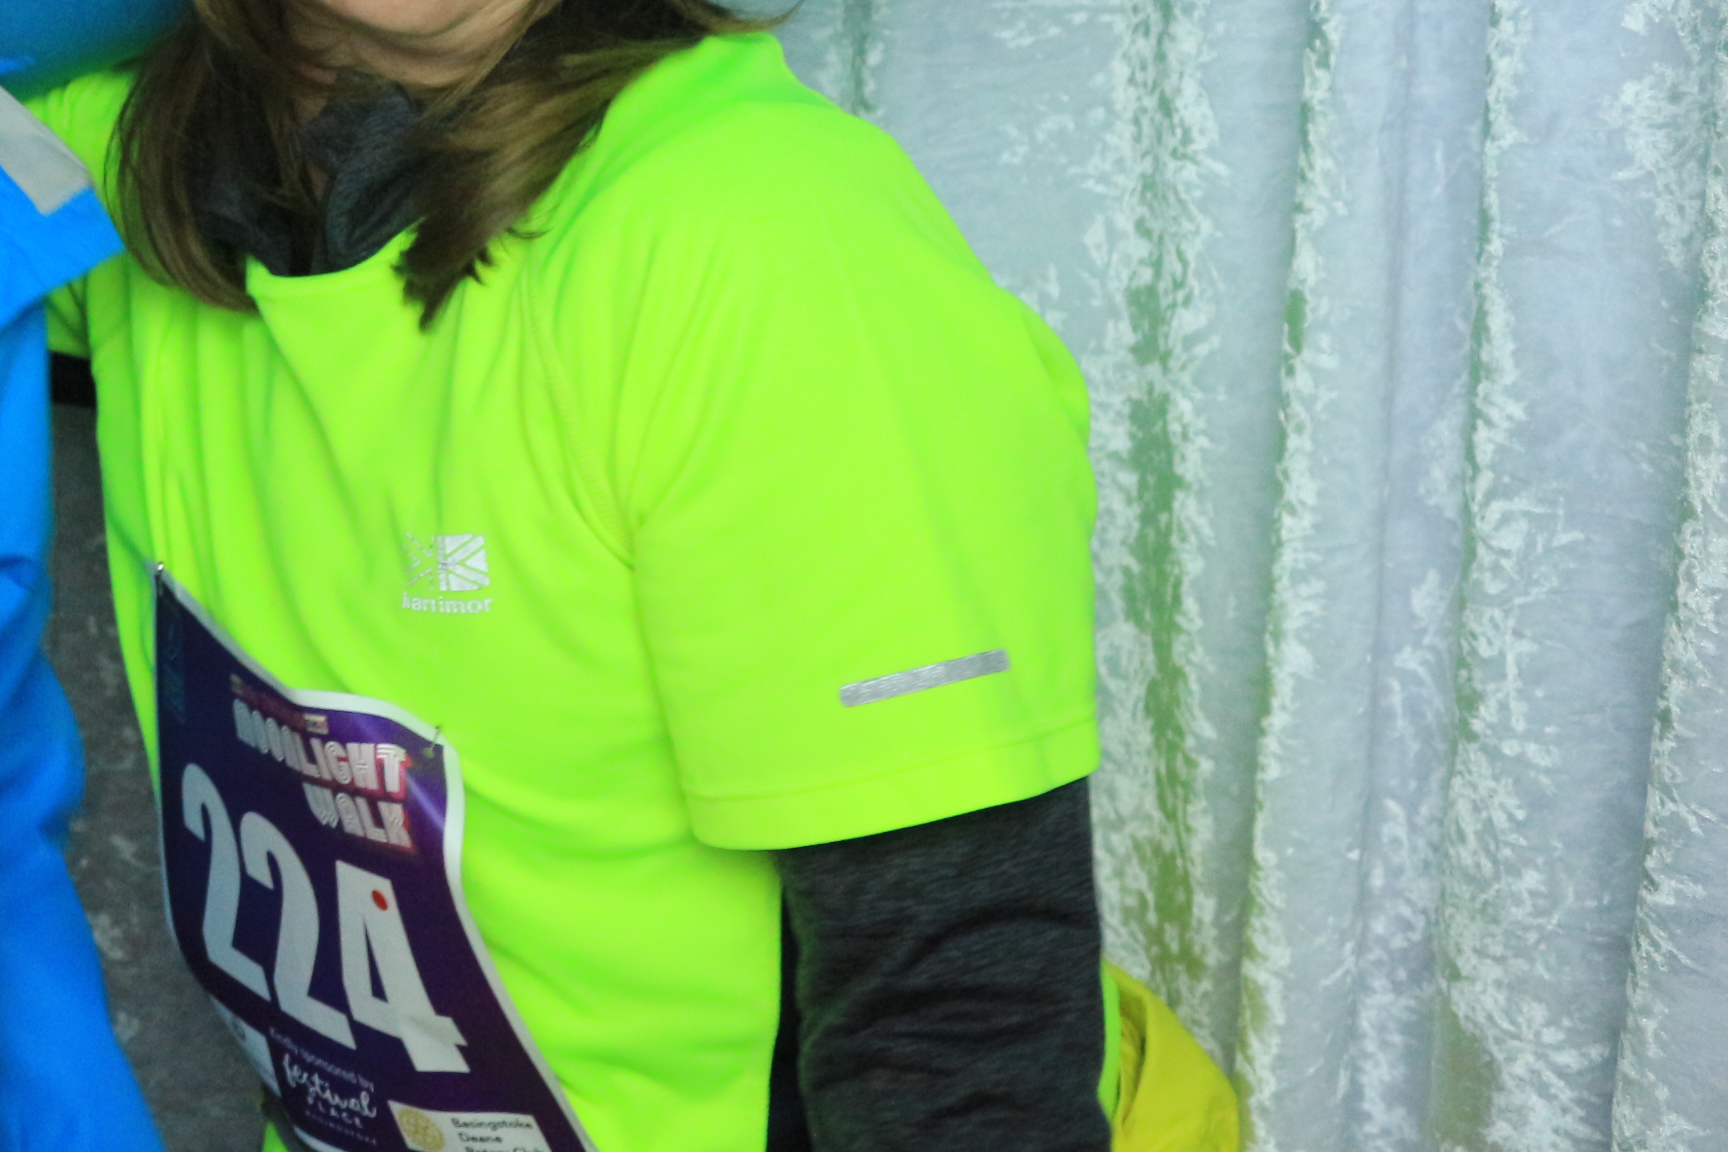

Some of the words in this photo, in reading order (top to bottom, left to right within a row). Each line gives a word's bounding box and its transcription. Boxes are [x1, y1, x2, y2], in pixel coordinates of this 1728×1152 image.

[233, 699, 407, 794] MOONLIGHT
[302, 781, 413, 849] WALK
[181, 763, 470, 1073] 224
[283, 1053, 377, 1118] festival
